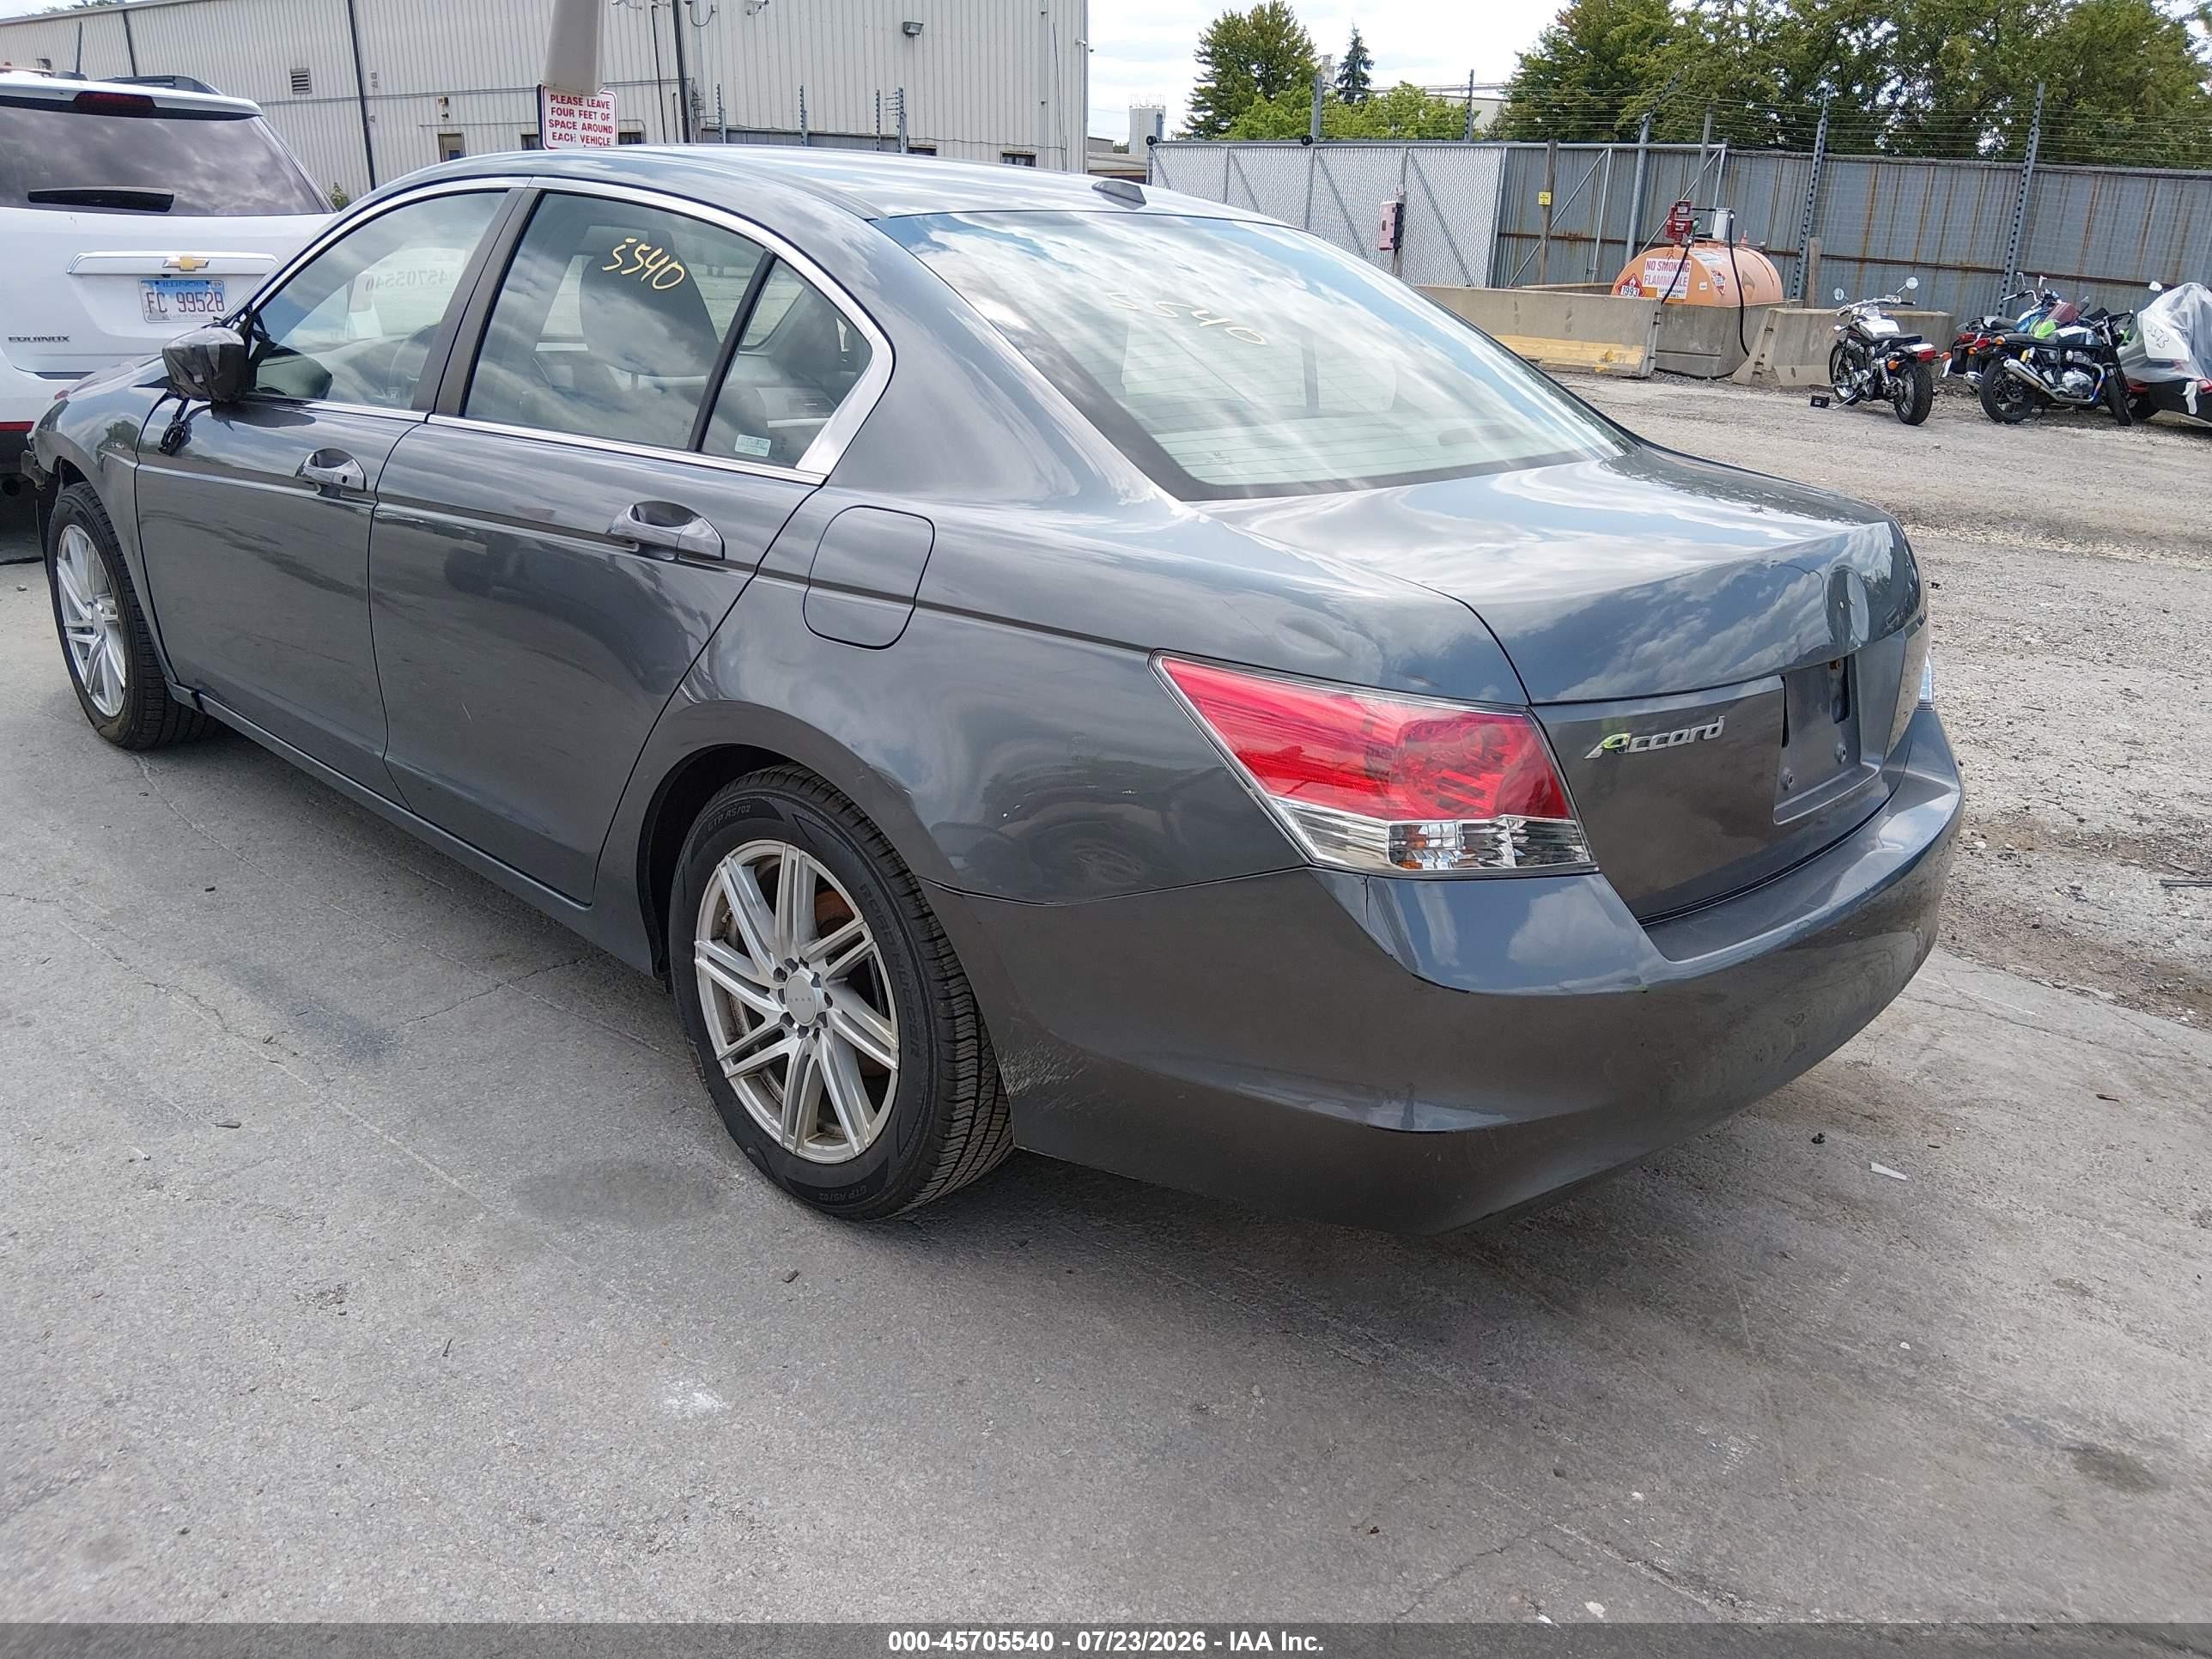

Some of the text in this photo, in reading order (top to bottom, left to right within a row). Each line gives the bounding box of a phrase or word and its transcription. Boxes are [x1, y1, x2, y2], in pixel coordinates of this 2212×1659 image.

[550, 94, 611, 110] PLEASE LEAVE
[550, 106, 611, 122] FOUR FEET OF
[549, 118, 613, 134] SPACE AROUND
[551, 131, 611, 146] EACH VEHICLE
[602, 237, 685, 290] 5540
[1646, 260, 1691, 273] NO SMOKNG
[1622, 286, 1638, 297] 1993
[146, 292, 225, 313] FC 99528
[1106, 292, 1267, 344] 5540
[1583, 715, 1726, 759] Accord
